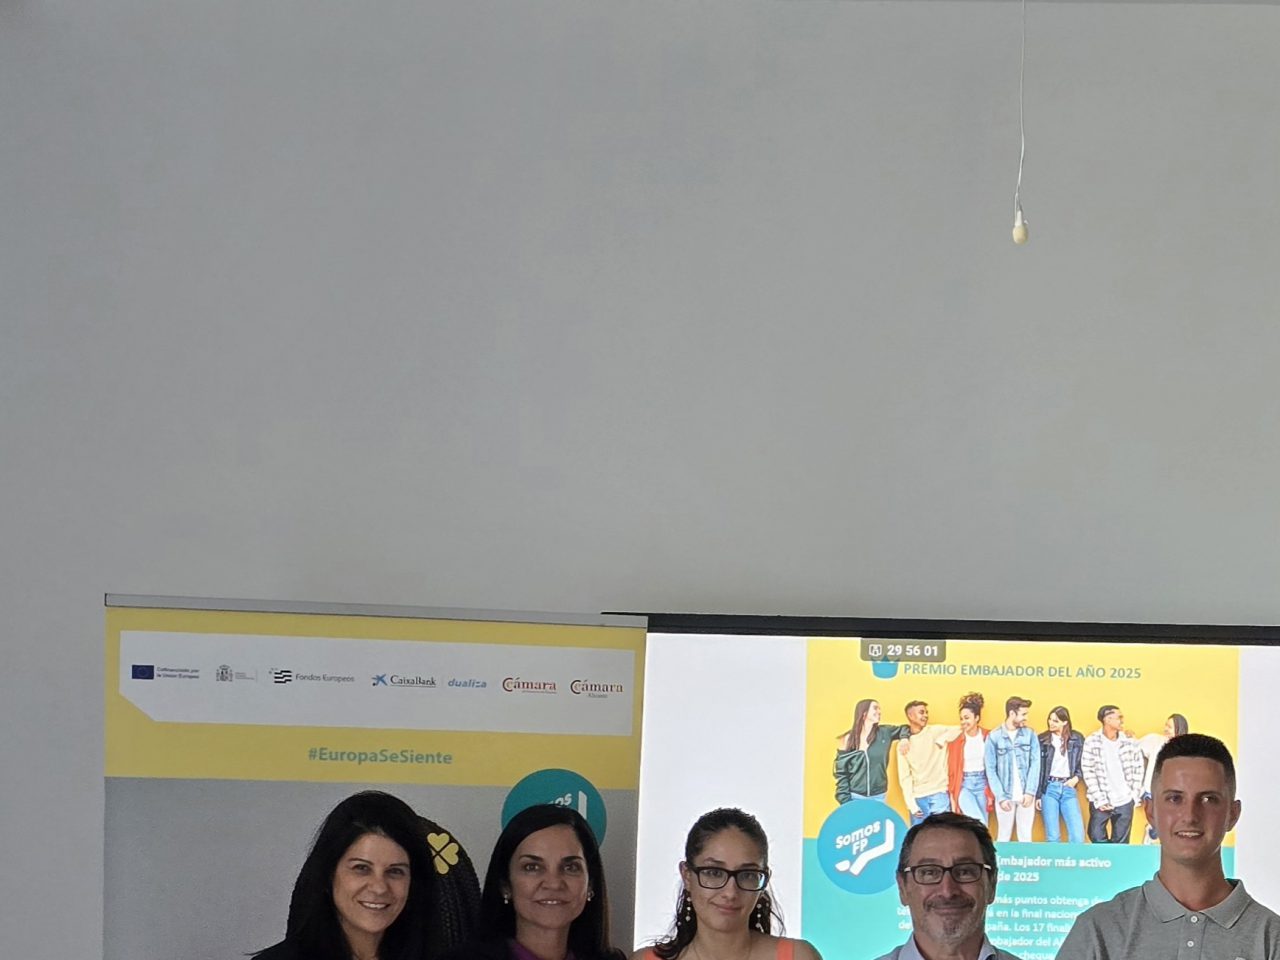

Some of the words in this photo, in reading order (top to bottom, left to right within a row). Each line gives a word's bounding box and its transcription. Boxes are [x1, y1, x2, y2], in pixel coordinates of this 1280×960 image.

[887, 645, 902, 656] 29
[905, 645, 921, 656] 56
[923, 646, 938, 657] 01
[904, 663, 957, 675] PREMIO
[961, 664, 1044, 678] EMBAJADOR
[1048, 667, 1072, 677] DEL
[1076, 664, 1106, 678] AÑO
[1110, 667, 1142, 679] 2025
[295, 674, 321, 682] Fondos
[323, 674, 355, 683] Europeos
[390, 675, 437, 687] CaixaBank
[448, 678, 487, 689] dualiza
[502, 677, 557, 692] Cámara
[570, 679, 623, 695] Cámara
[308, 747, 453, 765] #EuropaSeSiente
[835, 820, 881, 849] Somos
[852, 838, 869, 855] FP
[998, 855, 1052, 869] mbajador
[1055, 857, 1077, 868] más
[1079, 857, 1112, 868] activo
[1013, 872, 1040, 882] 2025
[1015, 895, 1048, 906] puntos
[1021, 909, 1043, 918] final
[1014, 924, 1030, 932] Los
